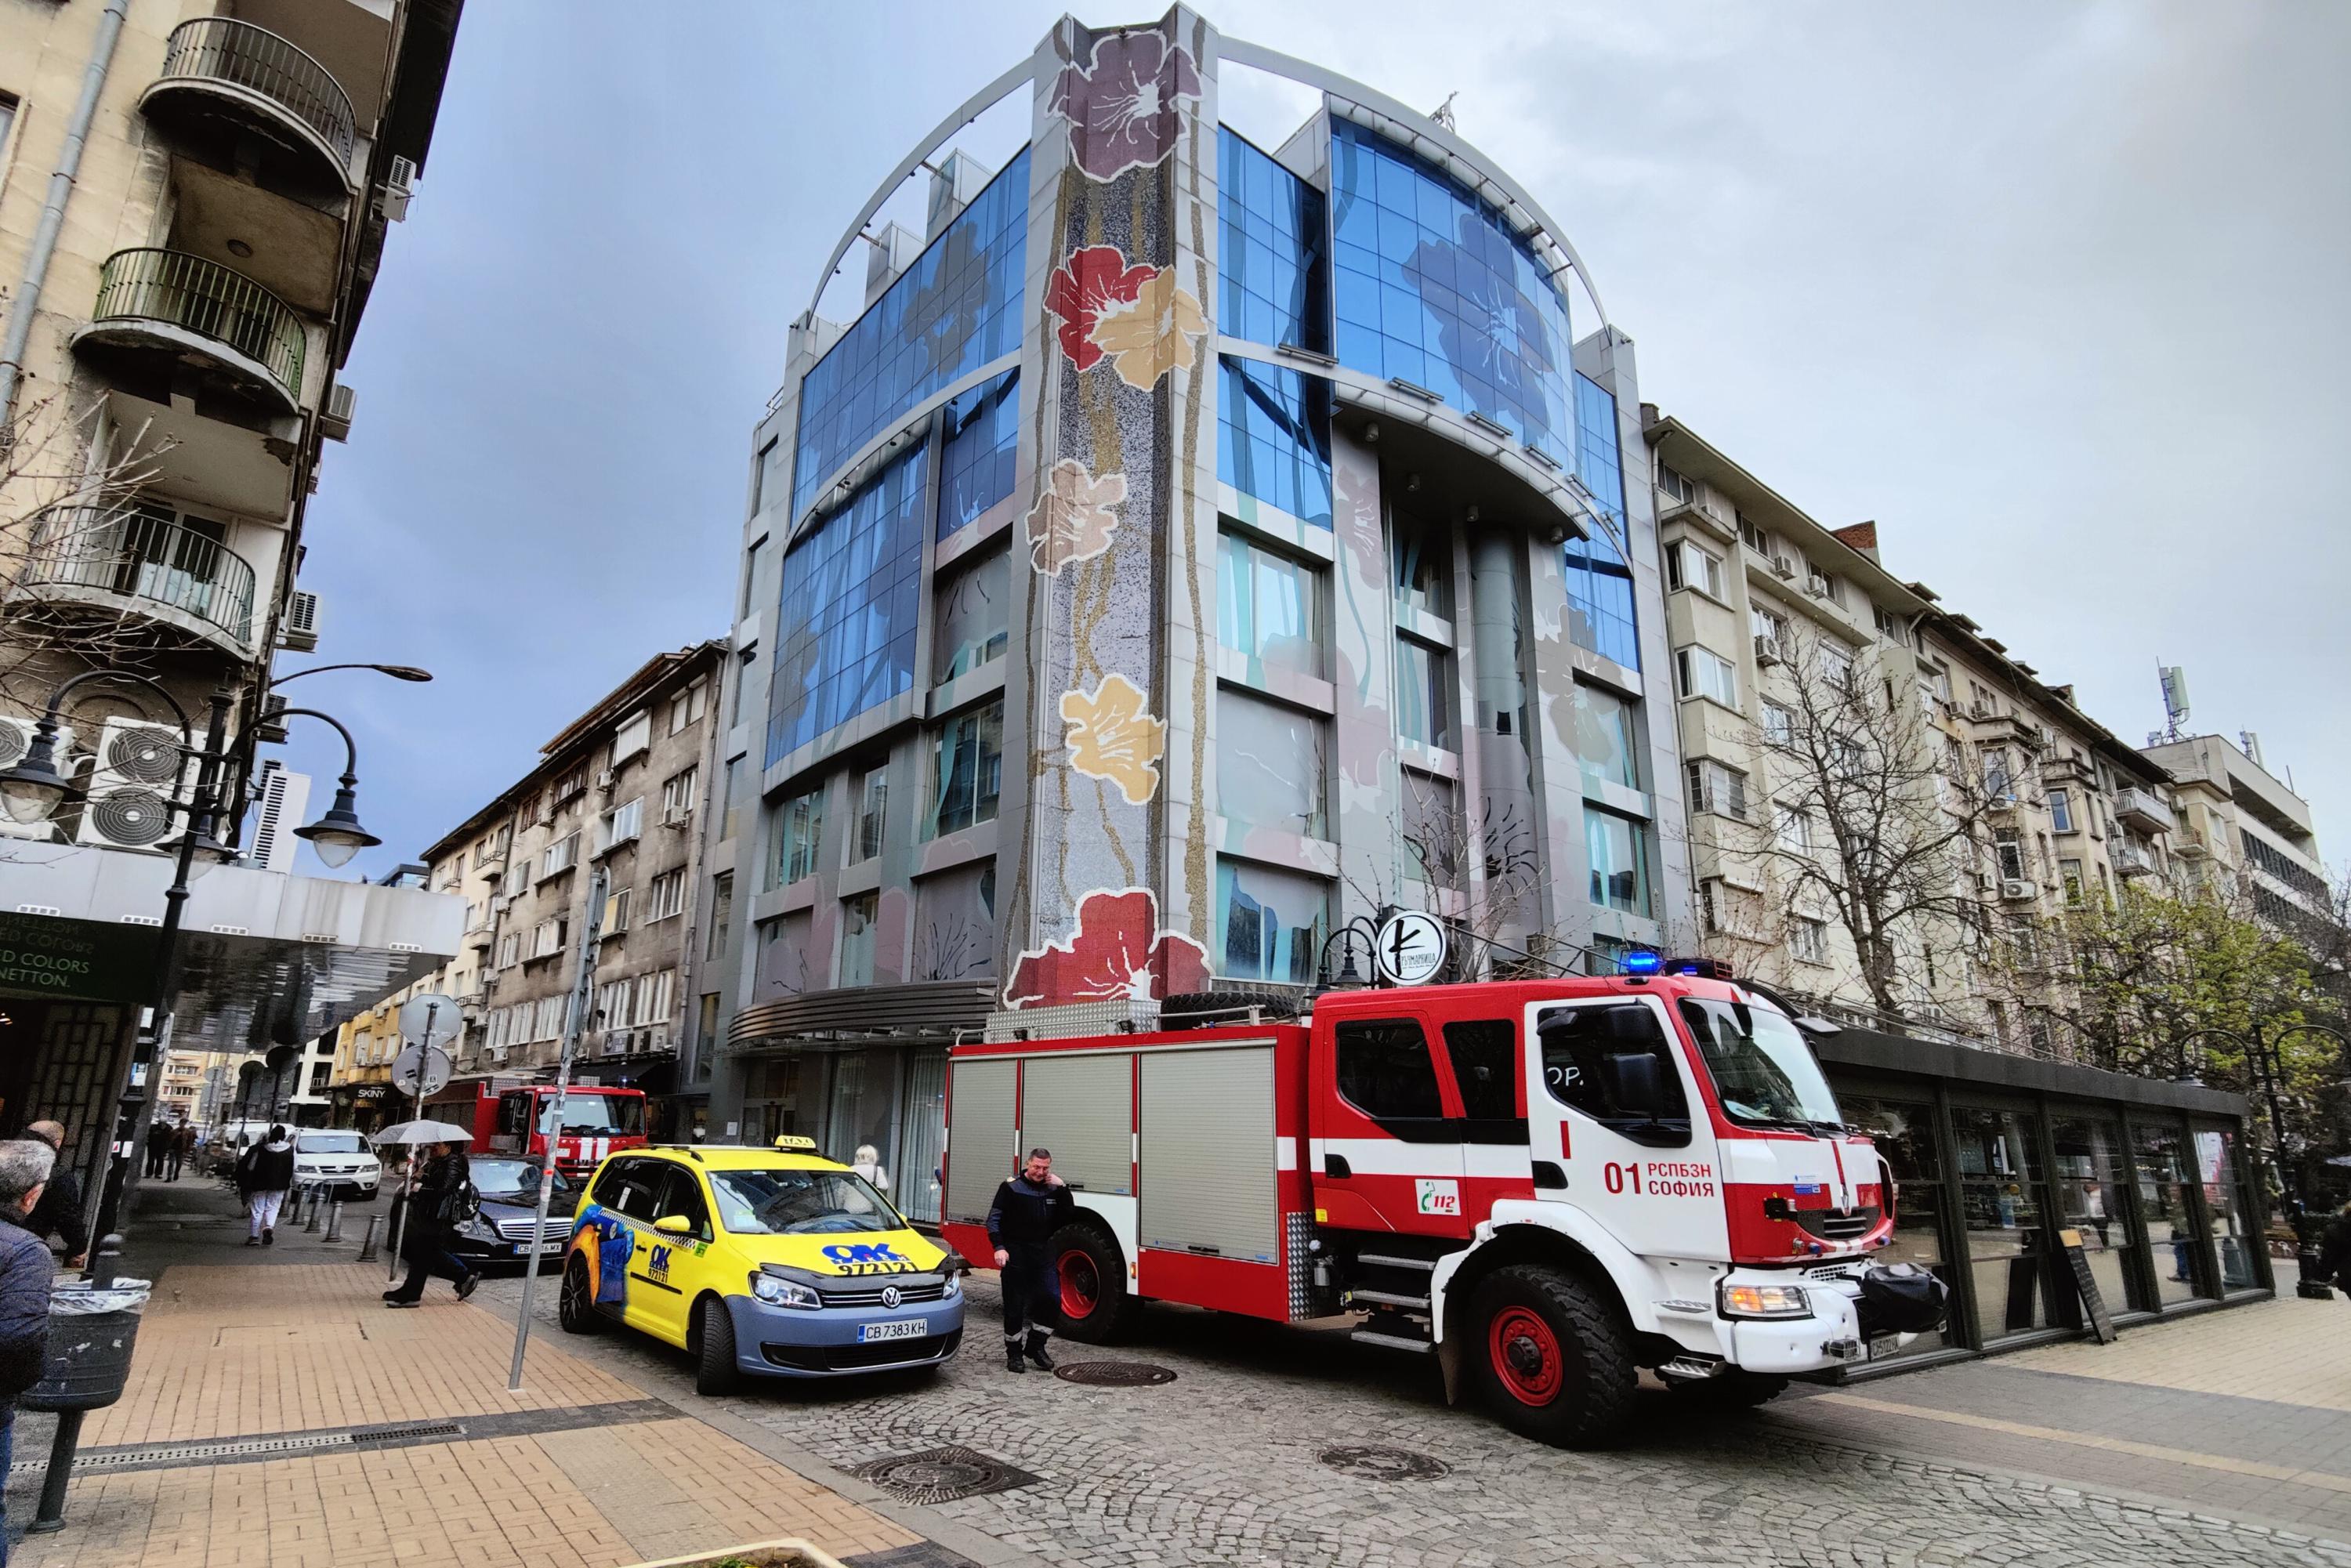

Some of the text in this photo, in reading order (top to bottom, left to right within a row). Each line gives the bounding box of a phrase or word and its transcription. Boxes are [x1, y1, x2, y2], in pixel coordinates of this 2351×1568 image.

[20, 953, 90, 973] COLORS
[358, 1089, 386, 1098] SKINY
[1604, 1162, 1712, 1194] 01 РСПБЗН
[1648, 1180, 1714, 1197] СОФИЯ
[1433, 1195, 1455, 1208] 112
[648, 1268, 668, 1283] 972121
[838, 1262, 919, 1276] 972121
[866, 1322, 925, 1339] CB 7383 KH
